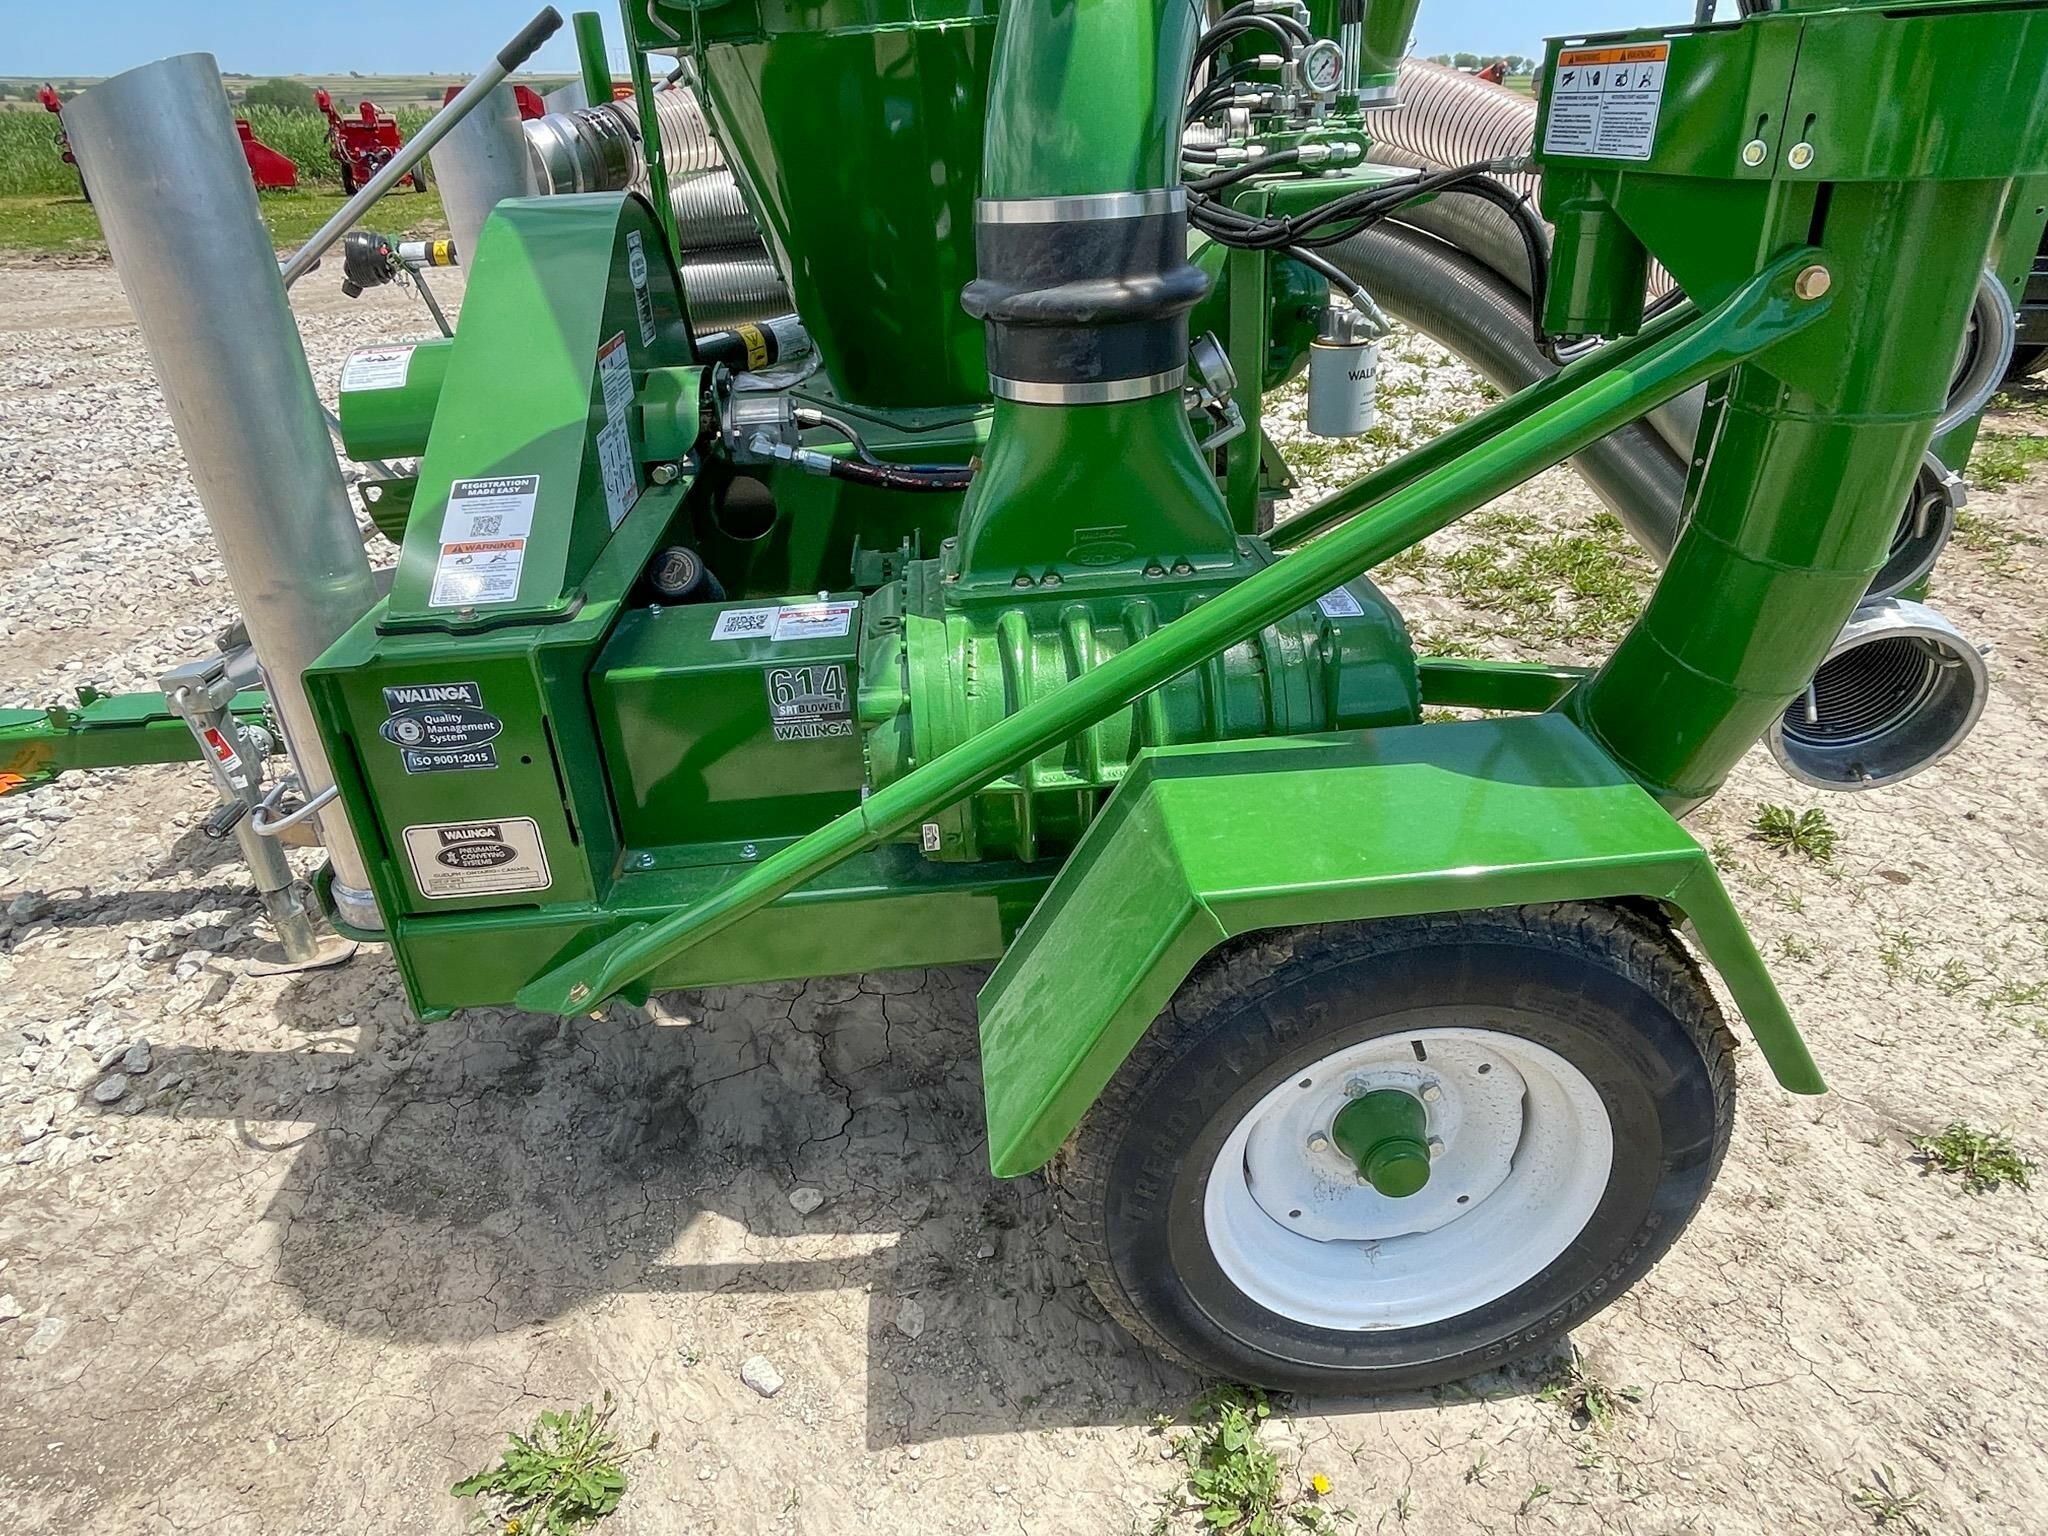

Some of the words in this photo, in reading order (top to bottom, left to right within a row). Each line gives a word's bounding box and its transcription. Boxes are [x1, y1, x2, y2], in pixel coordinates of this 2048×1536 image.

[461, 479, 530, 490] REGISTRATION
[467, 488, 494, 496] MADE
[496, 486, 521, 494] EASY
[465, 541, 516, 552] WARNING
[768, 665, 846, 707] 614
[394, 686, 471, 703] WALINGA
[424, 713, 462, 725] Quality
[427, 721, 495, 734] Management
[774, 721, 852, 741] WALINGA
[430, 733, 468, 744] System
[412, 756, 431, 766] ISO
[433, 752, 489, 765] 9001:2015
[444, 827, 496, 840] WALINGA
[459, 845, 501, 855] PNEUMATIC
[460, 851, 506, 861] CONVEYING
[462, 858, 493, 867] SYSTEMS
